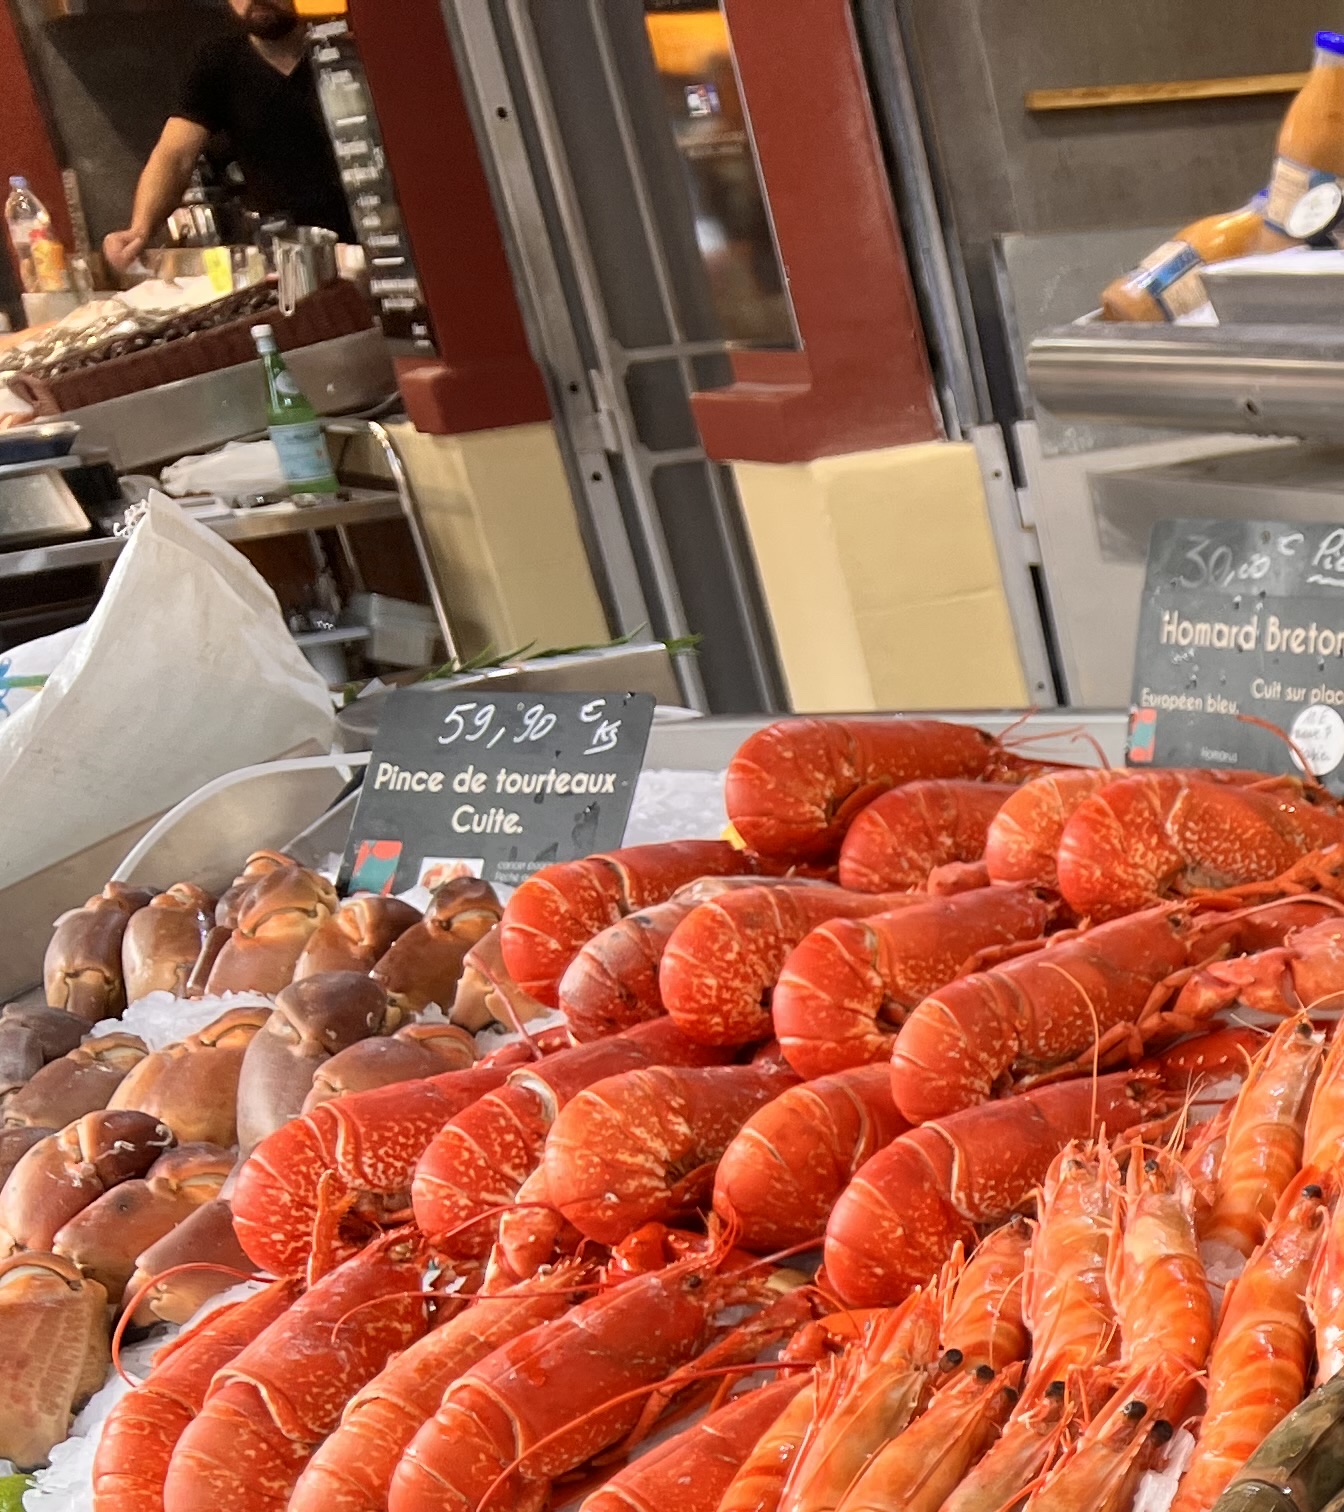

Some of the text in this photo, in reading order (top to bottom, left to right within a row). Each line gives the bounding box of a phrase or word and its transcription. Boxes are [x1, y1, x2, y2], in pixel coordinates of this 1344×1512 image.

[1160, 609, 1259, 651] Homard
[1141, 688, 1203, 713] Européen
[1252, 679, 1282, 700] Cuit
[1286, 682, 1307, 702] sur
[438, 702, 557, 749] 59,90
[374, 762, 617, 795] Pince de tourteaux
[451, 804, 524, 834] Cuite.
